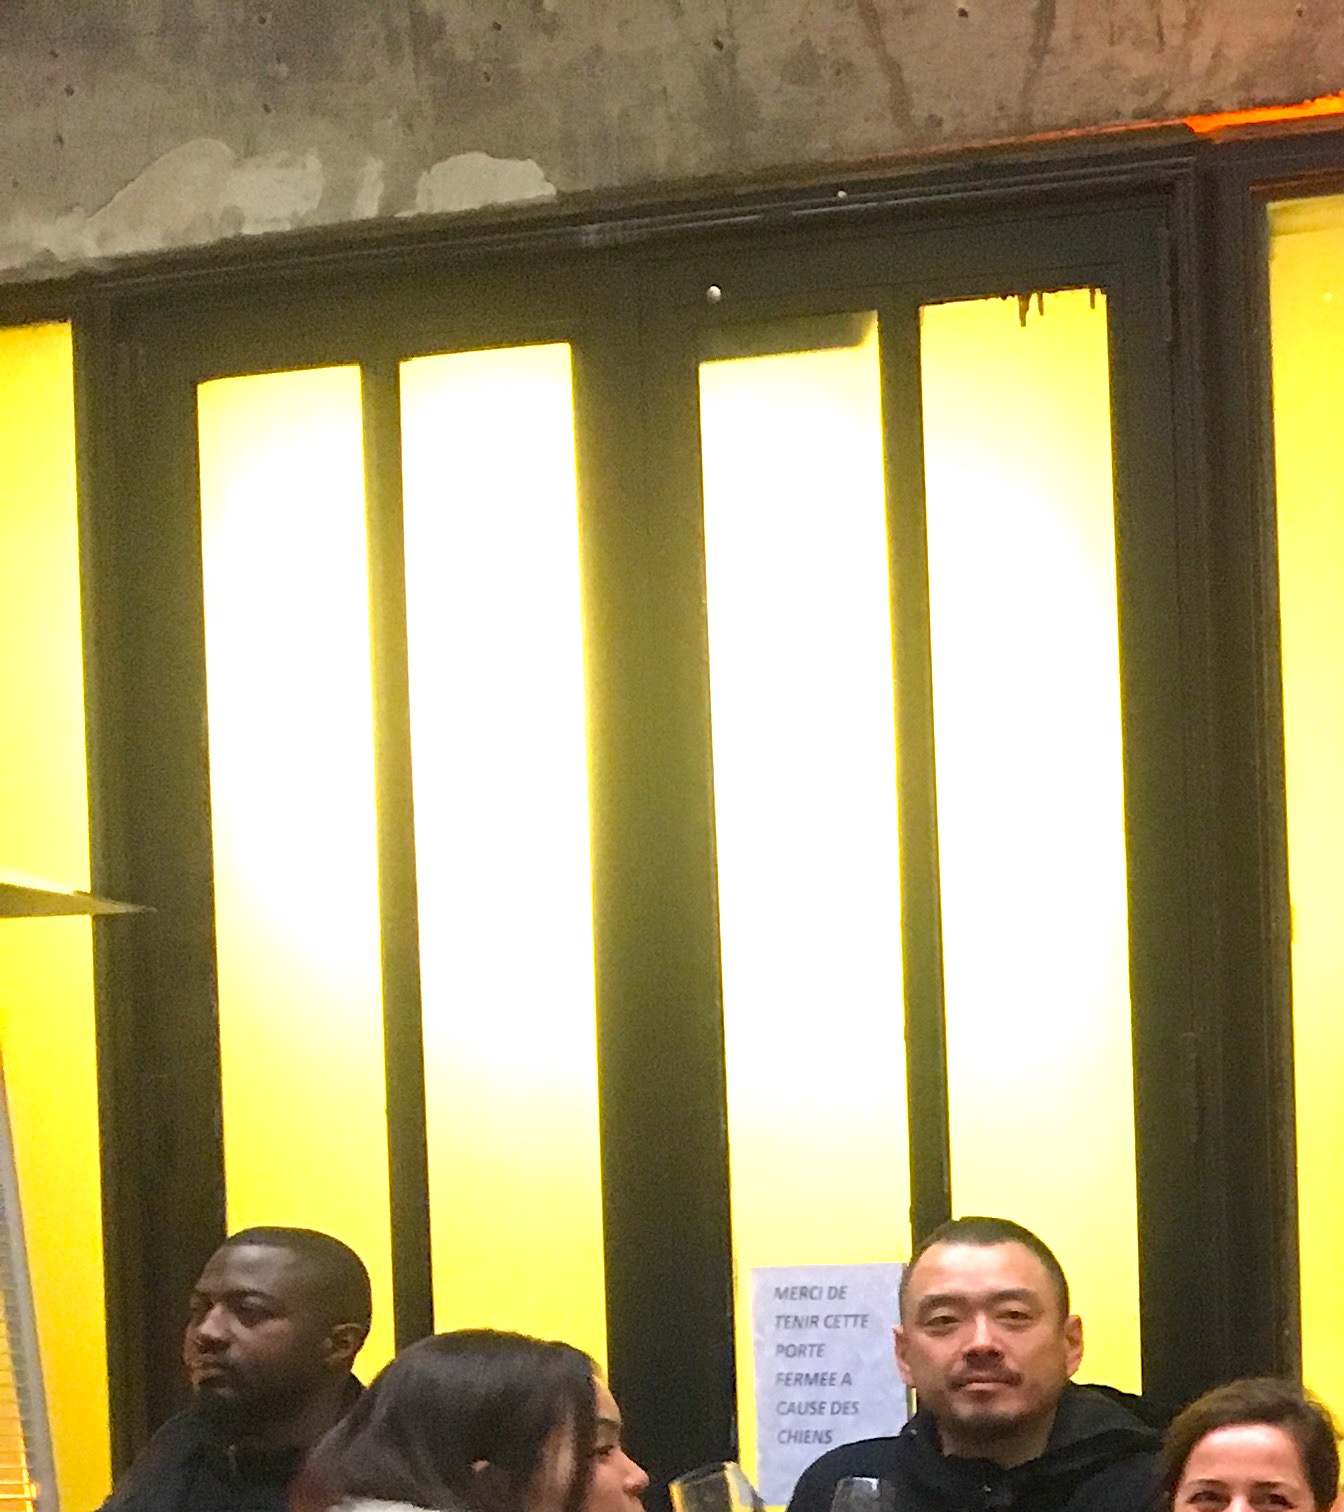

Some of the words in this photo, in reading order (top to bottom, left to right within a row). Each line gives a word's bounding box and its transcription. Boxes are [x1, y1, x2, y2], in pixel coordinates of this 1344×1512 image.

[774, 1286, 823, 1300] MERCI
[827, 1286, 848, 1300] DE
[775, 1314, 819, 1329] TENIR
[823, 1314, 869, 1329] CETTE
[776, 1343, 826, 1358] PORTE
[775, 1372, 837, 1387] FERMEE
[841, 1372, 852, 1386] A
[776, 1401, 827, 1415] CAUSE
[830, 1401, 859, 1415] DES
[777, 1429, 833, 1445] CHIENS
